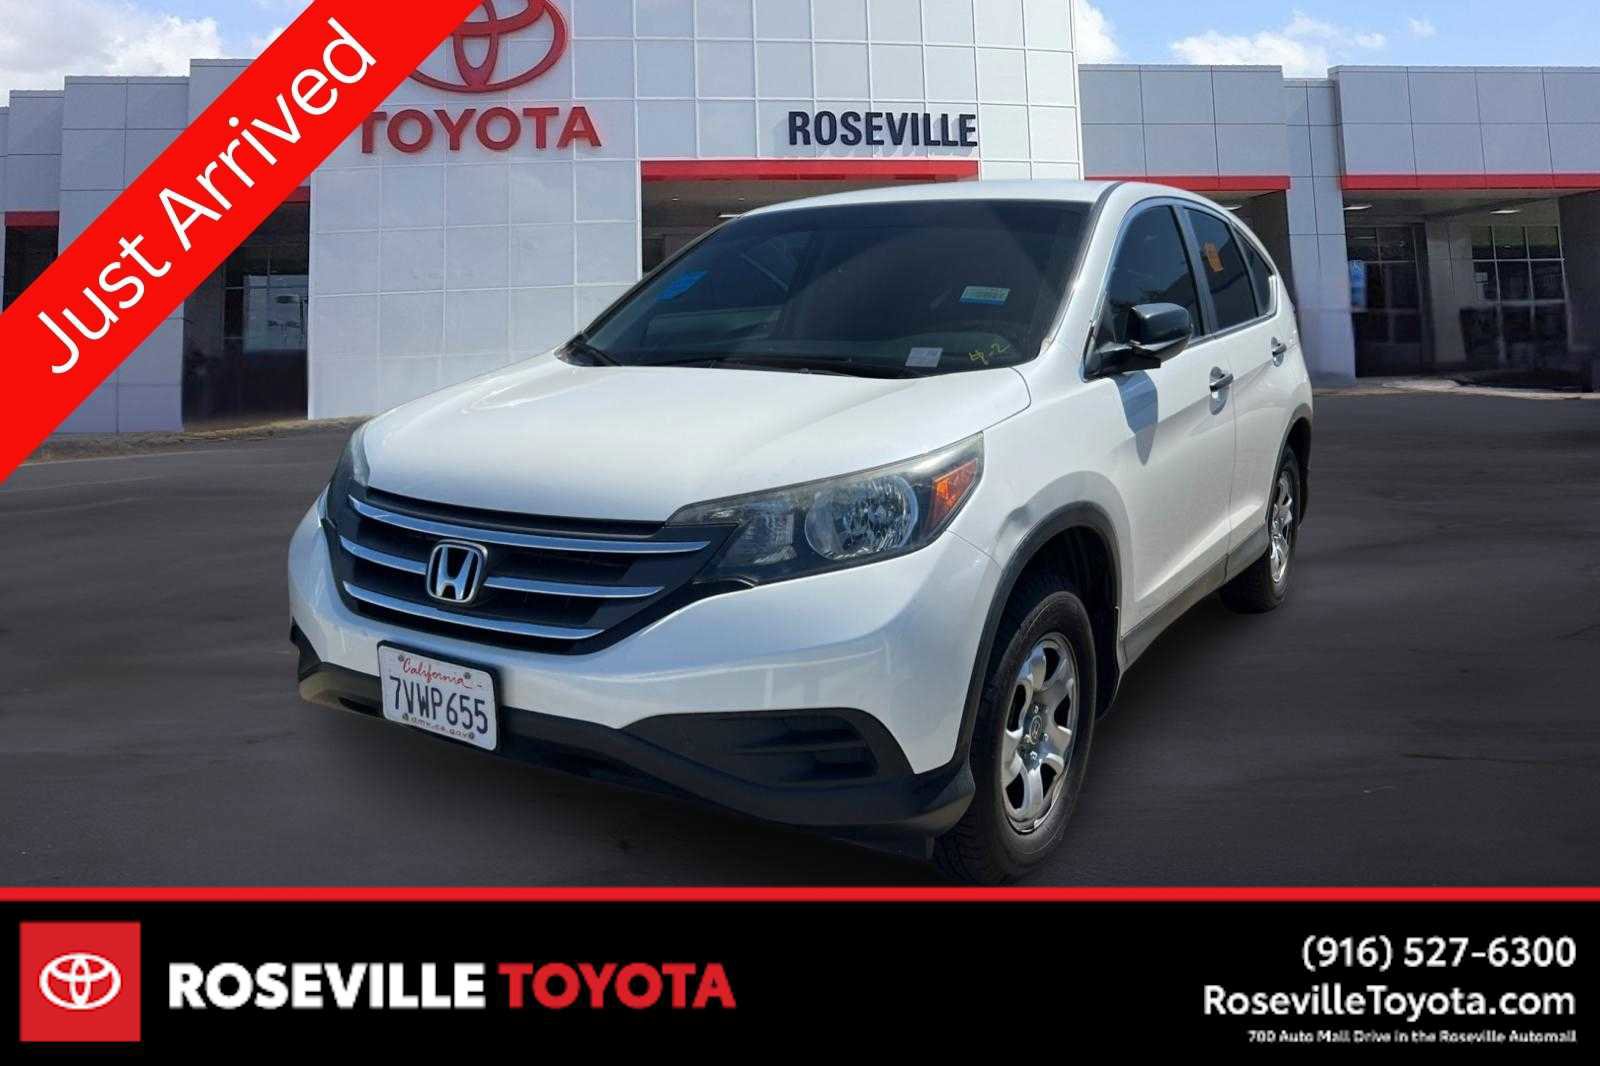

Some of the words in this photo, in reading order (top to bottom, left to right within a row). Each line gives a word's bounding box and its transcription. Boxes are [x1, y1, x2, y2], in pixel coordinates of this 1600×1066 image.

[361, 106, 602, 154] TOYOTA
[788, 110, 978, 147] ROSEVILLE
[402, 657, 467, 685] California
[389, 675, 489, 735] 7VWP655
